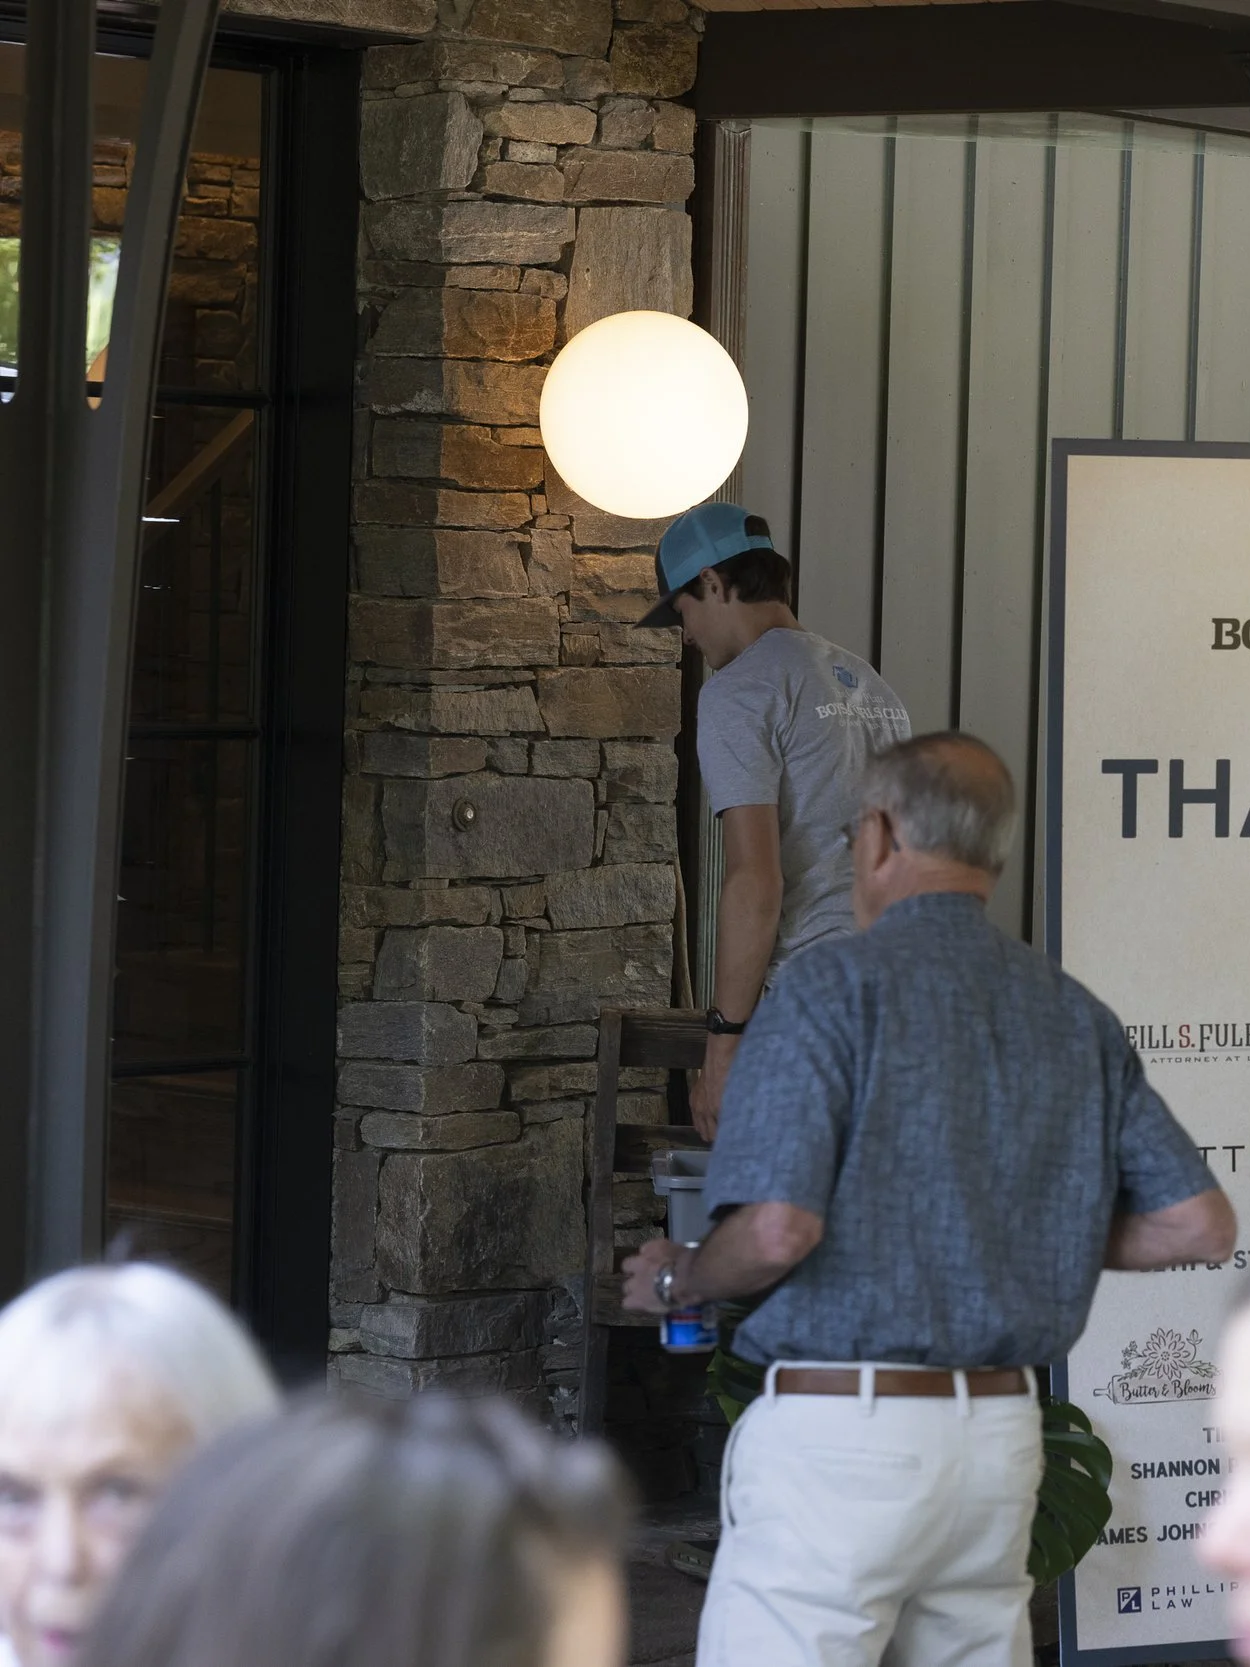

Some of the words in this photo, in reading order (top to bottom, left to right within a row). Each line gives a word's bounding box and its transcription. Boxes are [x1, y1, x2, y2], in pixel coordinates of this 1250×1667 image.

[1125, 1025, 1174, 1050] EILL
[1178, 1024, 1195, 1049] S.
[1151, 1056, 1218, 1064] ATTORNEY
[1120, 1382, 1160, 1401] Butter
[1161, 1384, 1170, 1397] &
[1171, 1379, 1217, 1399] Blooms
[1131, 1458, 1221, 1480] SHANNON
[1096, 1527, 1148, 1546] AMES
[1157, 1522, 1211, 1542] JOHN
[1152, 1581, 1240, 1597] PHILLIP
[1152, 1599, 1193, 1611] LAW
